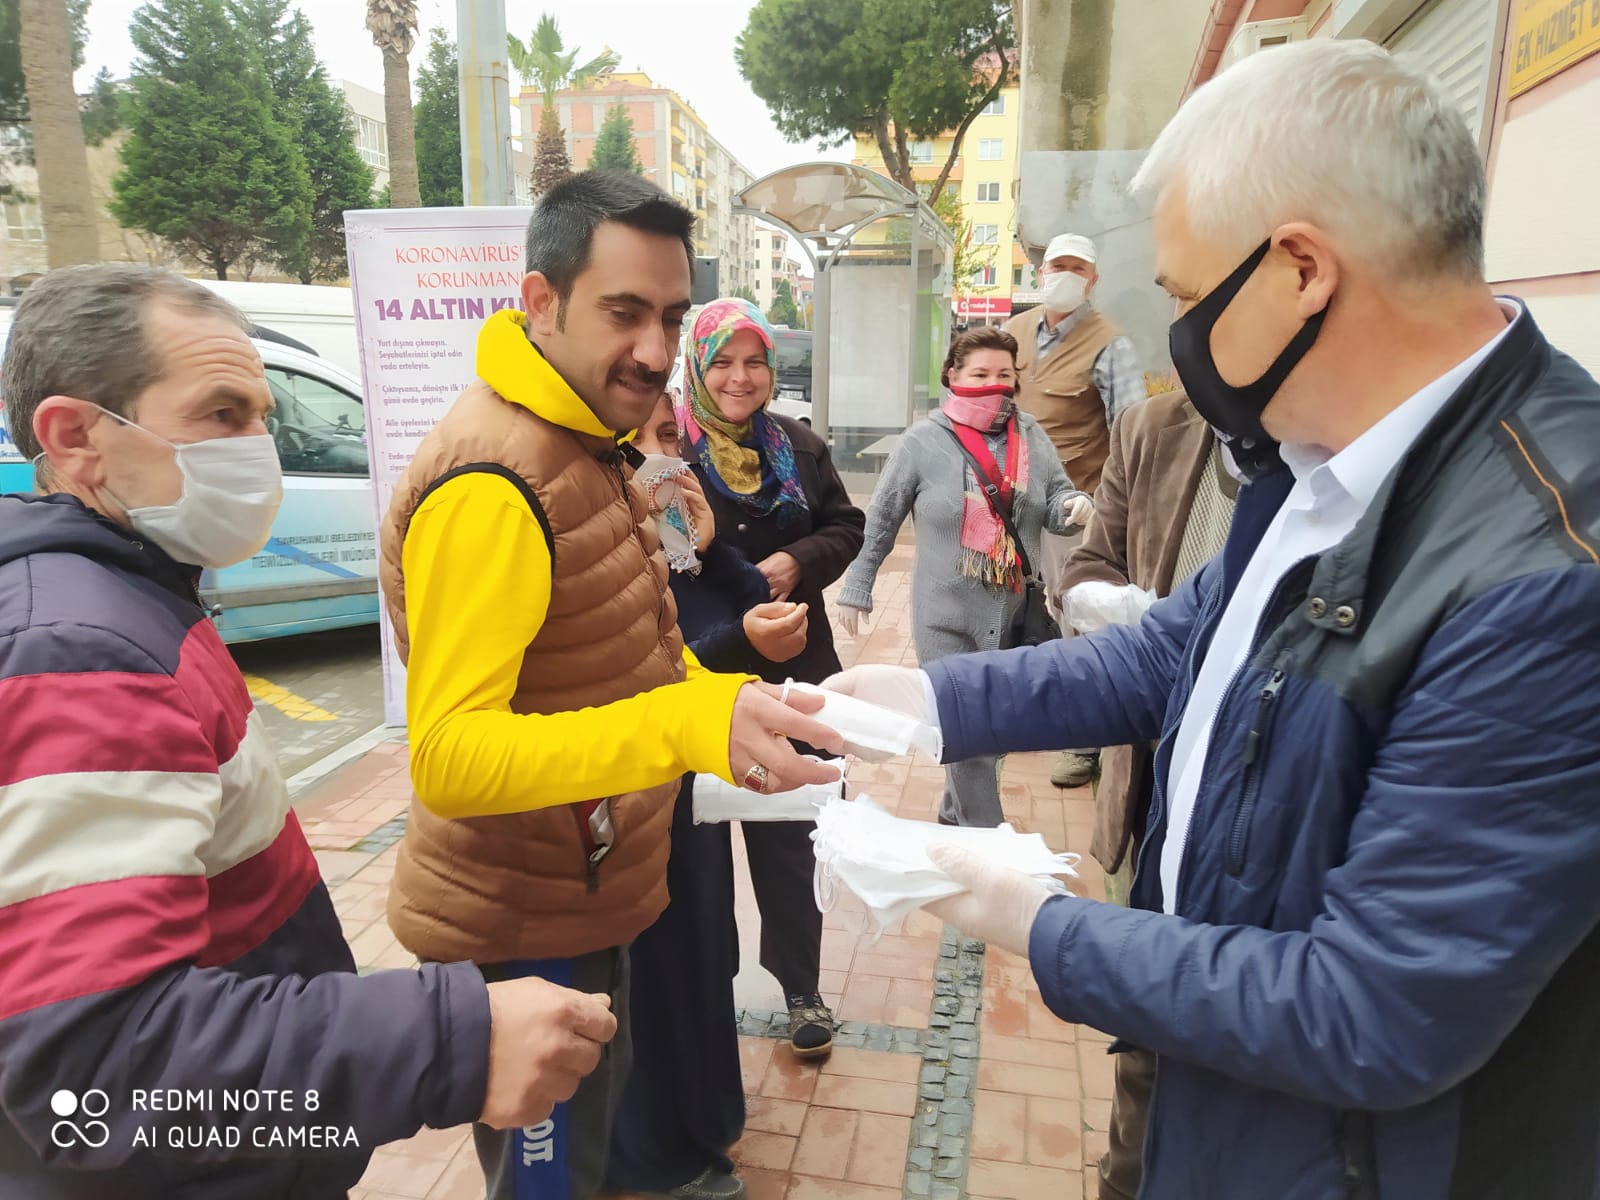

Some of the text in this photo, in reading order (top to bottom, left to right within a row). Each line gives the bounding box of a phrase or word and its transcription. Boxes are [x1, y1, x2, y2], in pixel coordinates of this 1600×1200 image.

[375, 299, 403, 320] 14
[410, 298, 484, 320] ALTIN
[448, 349, 463, 357] edin
